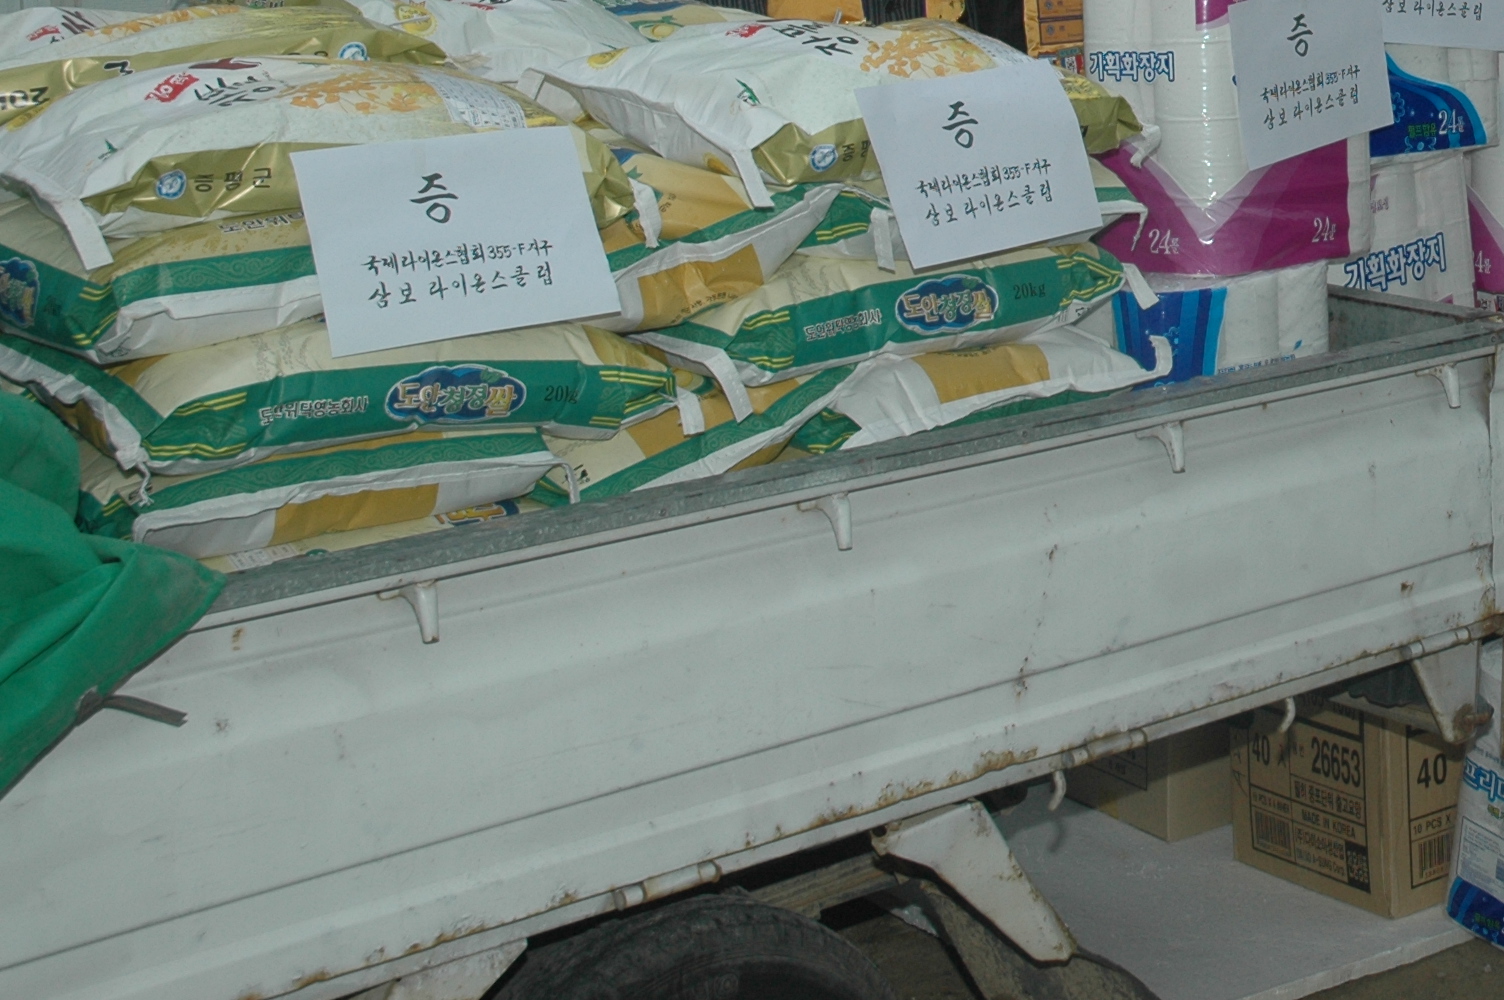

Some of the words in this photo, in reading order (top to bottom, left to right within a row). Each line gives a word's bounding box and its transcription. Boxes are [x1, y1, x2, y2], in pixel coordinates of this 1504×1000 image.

[1286, 13, 1313, 57] 증
[1089, 51, 1175, 83] 기획화장지
[942, 100, 978, 149] 증
[409, 173, 459, 224] 증
[1148, 229, 1180, 255] 24롤
[1311, 216, 1337, 243] 24롤
[1344, 232, 1447, 291] 기획화장지
[1475, 250, 1492, 274] 4롤
[1013, 283, 1047, 300] 20kg
[397, 381, 519, 418] 도안청정쌀
[1252, 733, 1270, 766] 40
[1311, 737, 1362, 788] 26653
[1417, 754, 1448, 789] 40
[1301, 809, 1321, 825] MADE
[1323, 816, 1330, 830] IN
[1332, 819, 1356, 840] KOREA
[1413, 823, 1423, 835] 10
[1426, 818, 1443, 832] PCS
